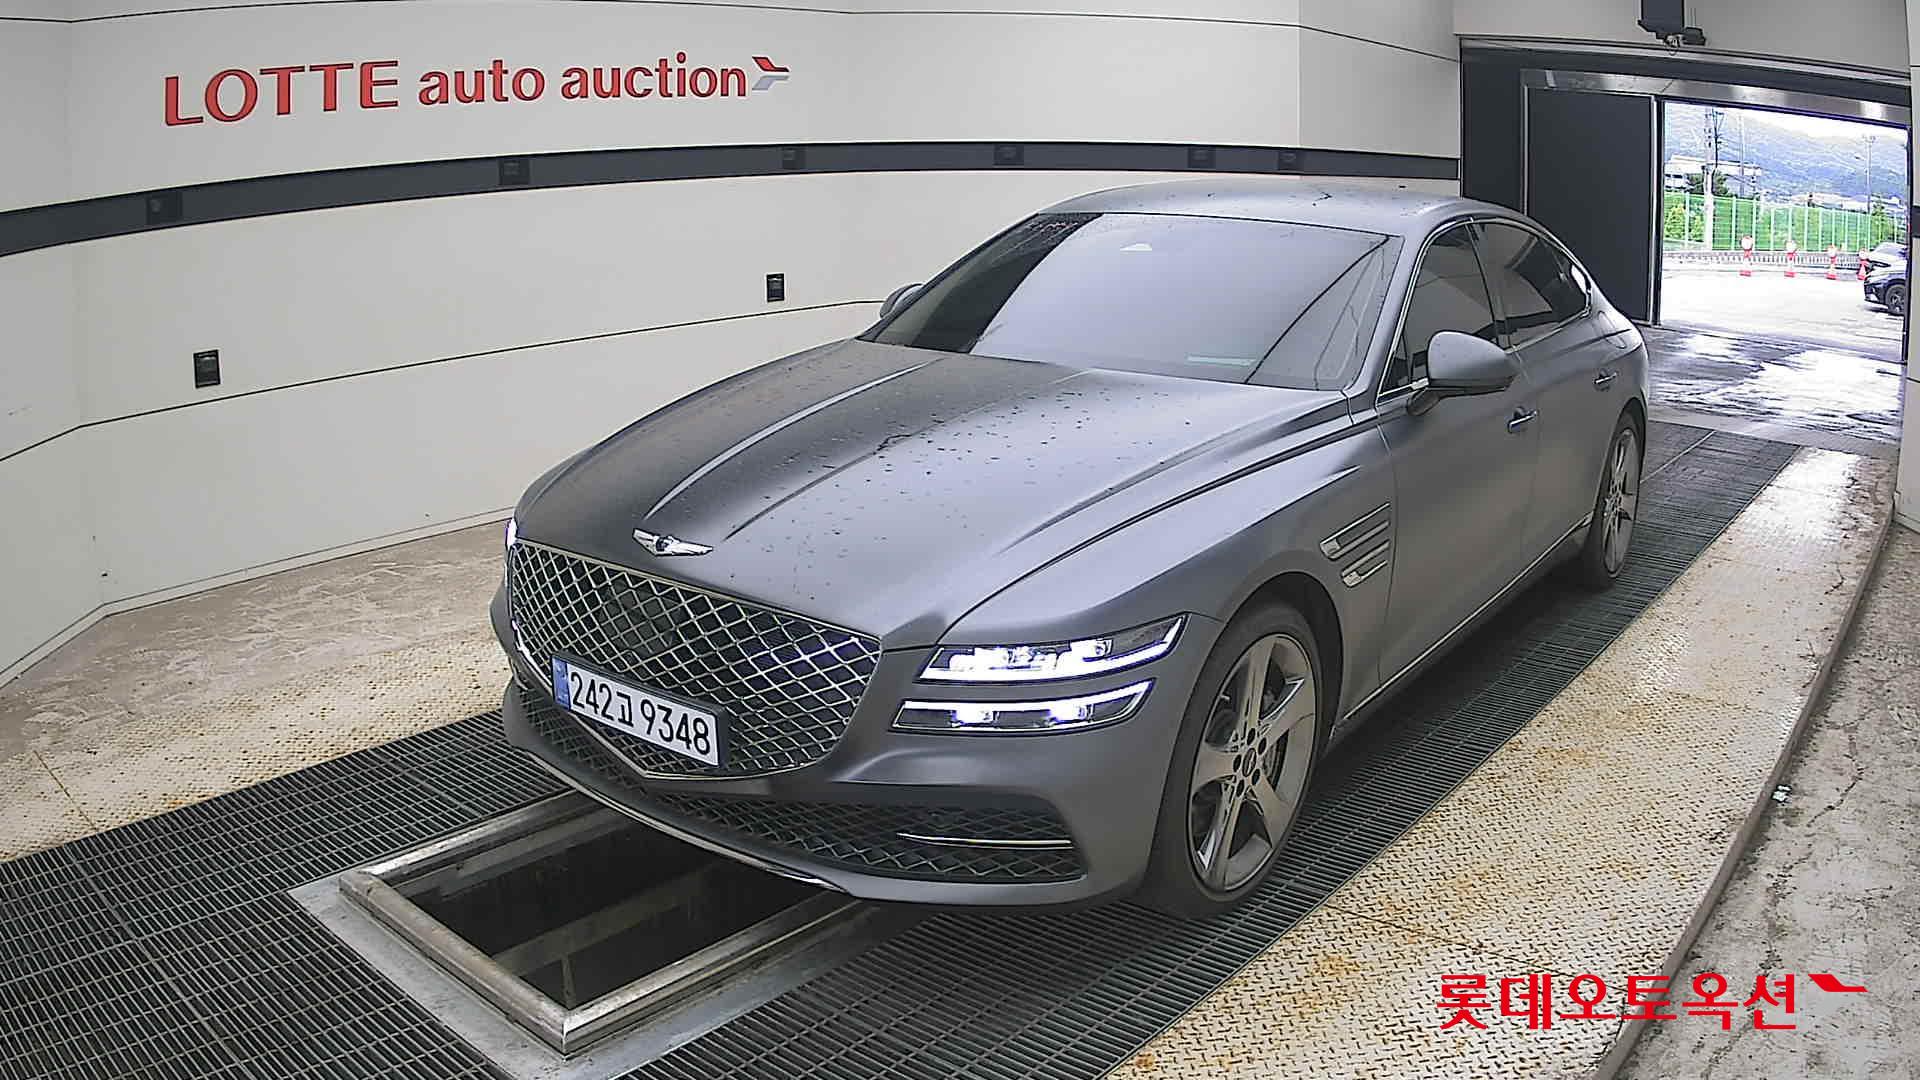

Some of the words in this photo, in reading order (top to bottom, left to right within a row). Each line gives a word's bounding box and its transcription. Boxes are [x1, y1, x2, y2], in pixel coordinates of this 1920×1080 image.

[163, 60, 400, 127] LOTTE
[417, 58, 547, 105] auto
[560, 51, 748, 100] auction
[570, 671, 634, 728] 242고
[639, 698, 711, 756] 9348
